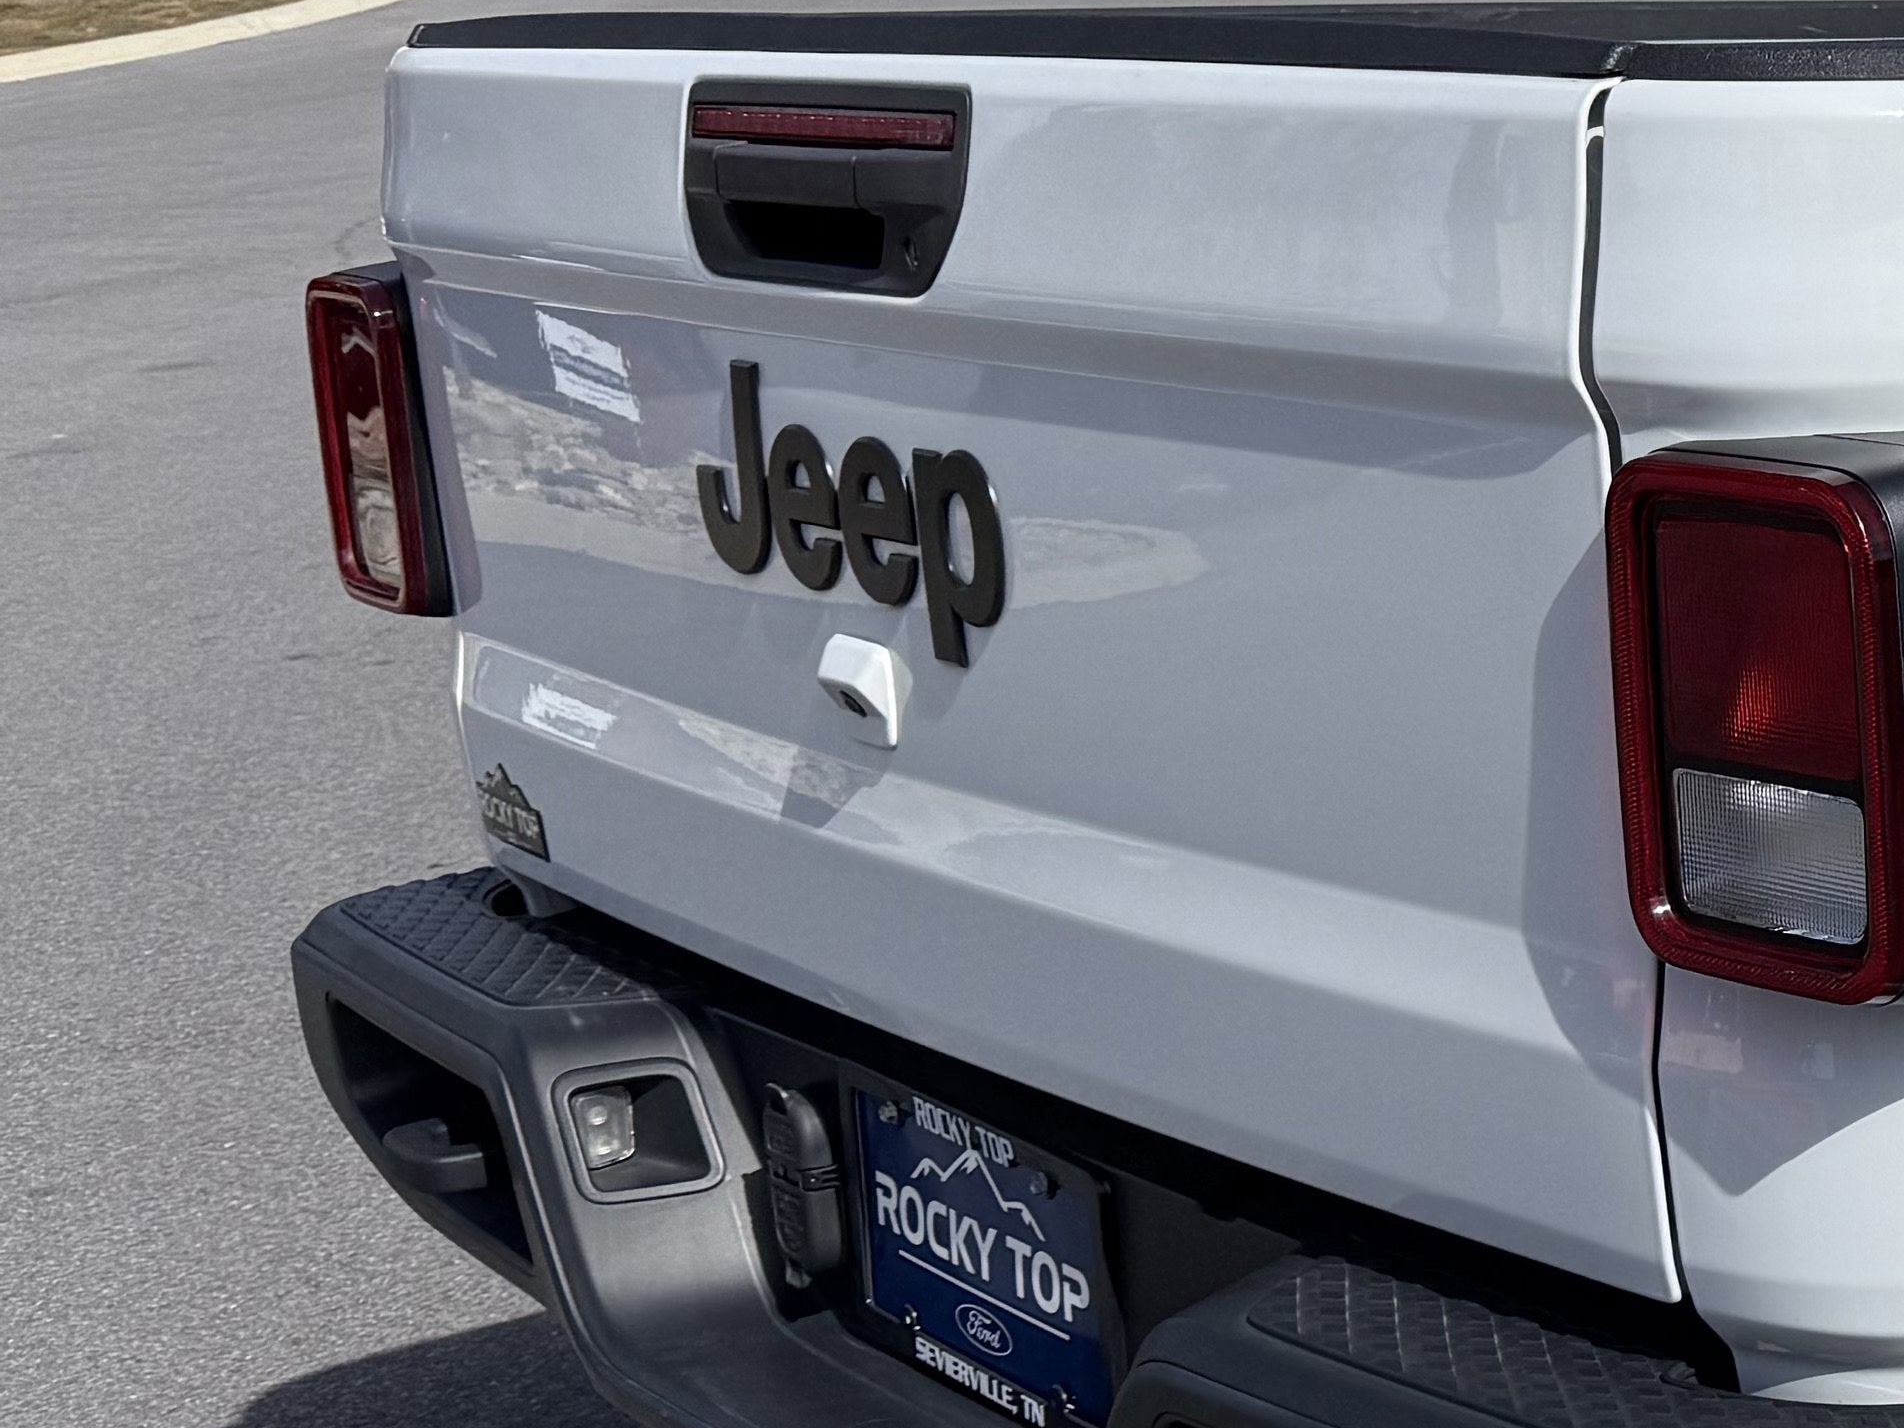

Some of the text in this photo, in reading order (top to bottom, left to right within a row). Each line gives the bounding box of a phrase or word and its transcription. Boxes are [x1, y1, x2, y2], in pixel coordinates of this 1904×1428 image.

[695, 360, 1006, 667] Jeep
[912, 1095, 1015, 1168] ROCKY TOP
[875, 1170, 1090, 1322] ROCKY TOP
[966, 1310, 1002, 1349] Ford
[915, 1336, 1045, 1428] SEVIERVILLE, TN
